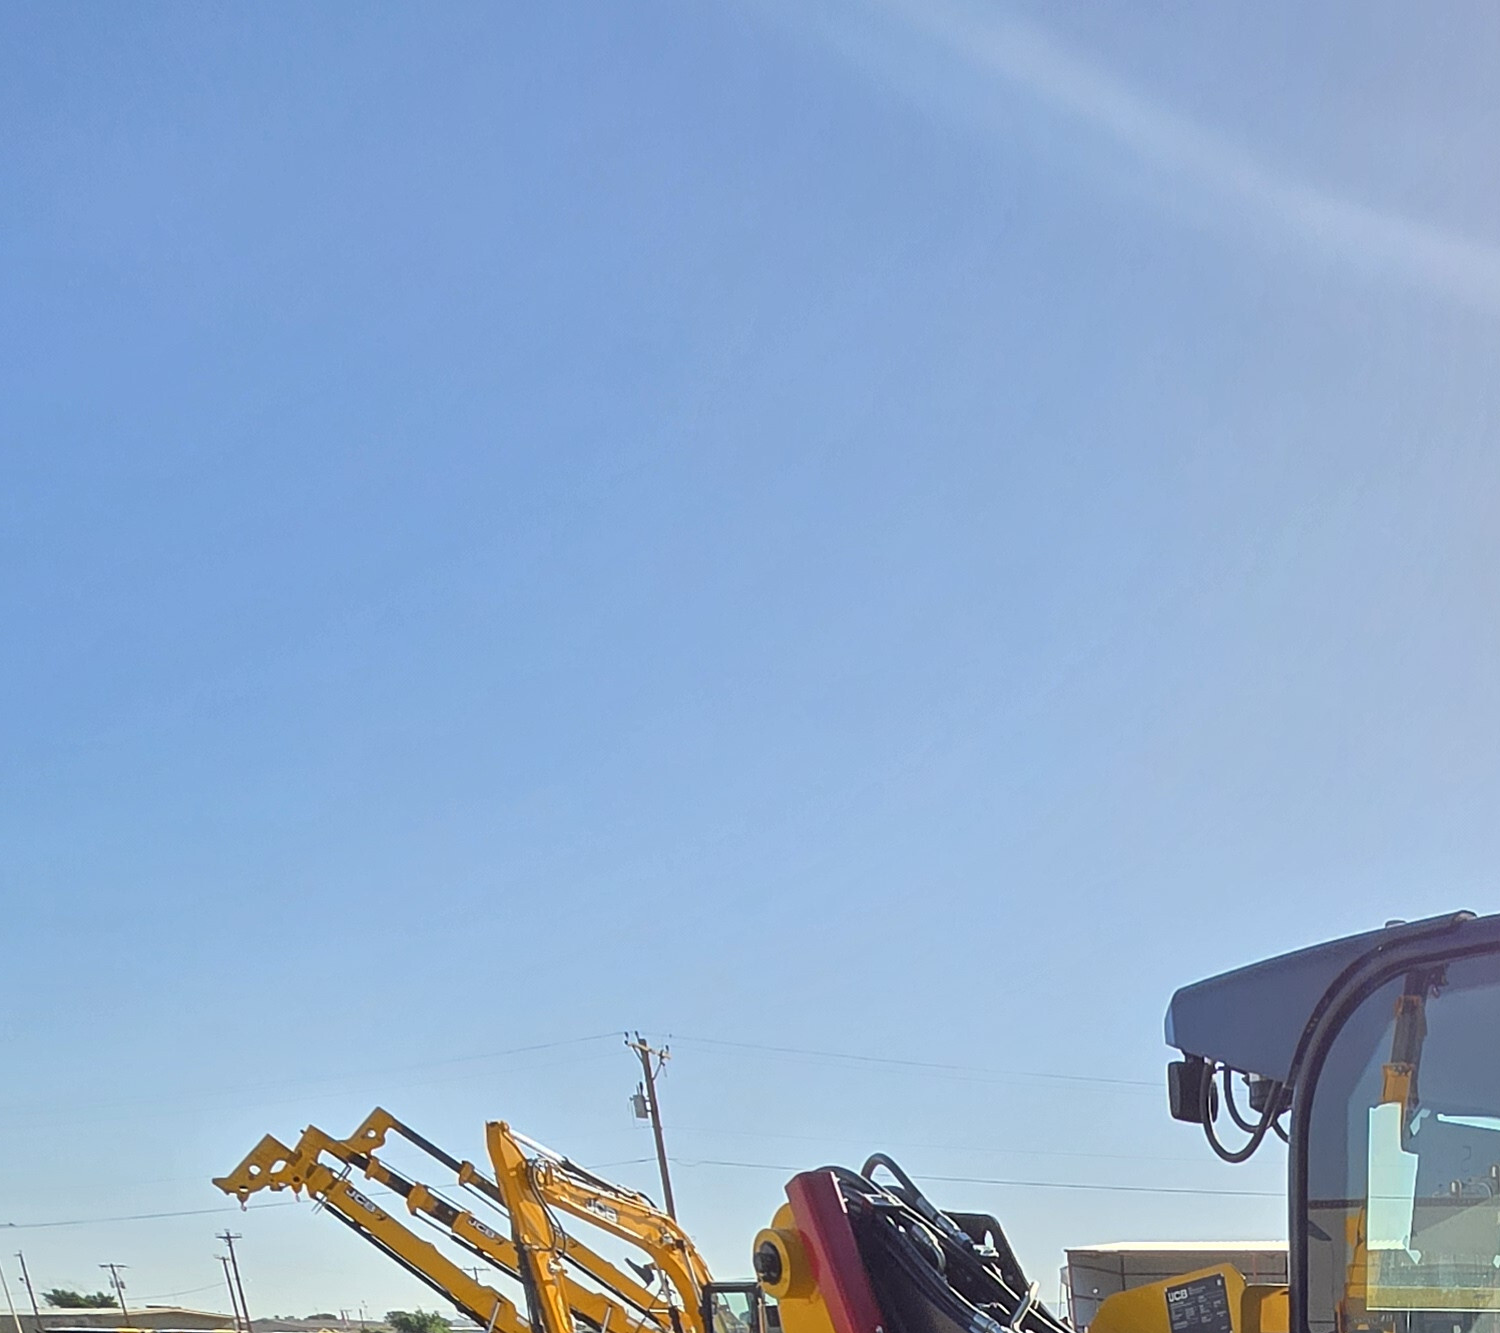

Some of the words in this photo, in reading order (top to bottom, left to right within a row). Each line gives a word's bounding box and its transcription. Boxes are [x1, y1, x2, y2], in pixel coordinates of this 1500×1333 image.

[345, 1187, 377, 1213] JCB
[586, 1198, 618, 1224] JCB
[467, 1218, 497, 1239] JCB
